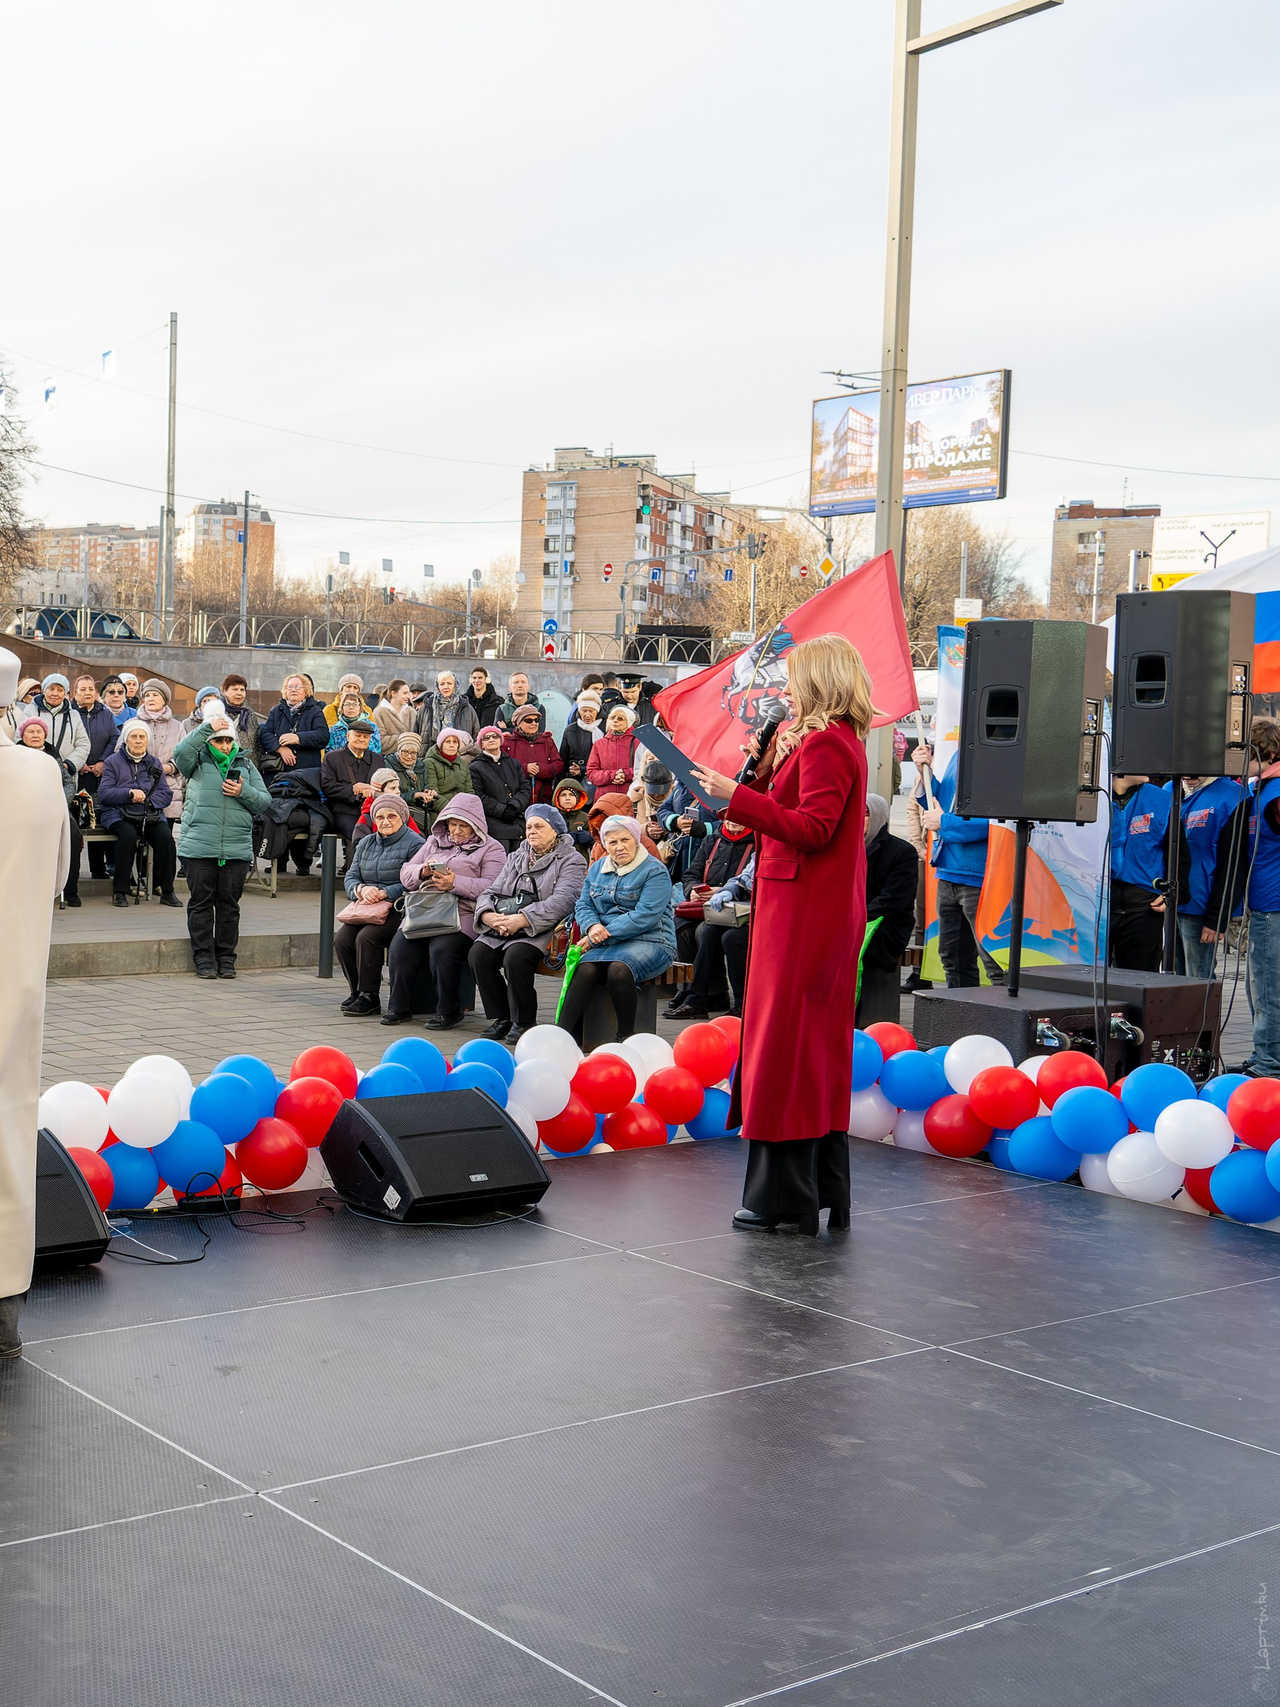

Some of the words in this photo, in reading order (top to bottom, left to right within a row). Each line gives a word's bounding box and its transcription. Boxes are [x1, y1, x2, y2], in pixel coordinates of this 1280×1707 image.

[906, 390, 939, 409] ИВЕР
[942, 383, 981, 403] ПАРК
[904, 441, 931, 455] ВЫЕ
[933, 433, 992, 452] КОРПУСА
[914, 446, 992, 470] ПРОДАЖЕ
[733, 633, 753, 641] СТОП
